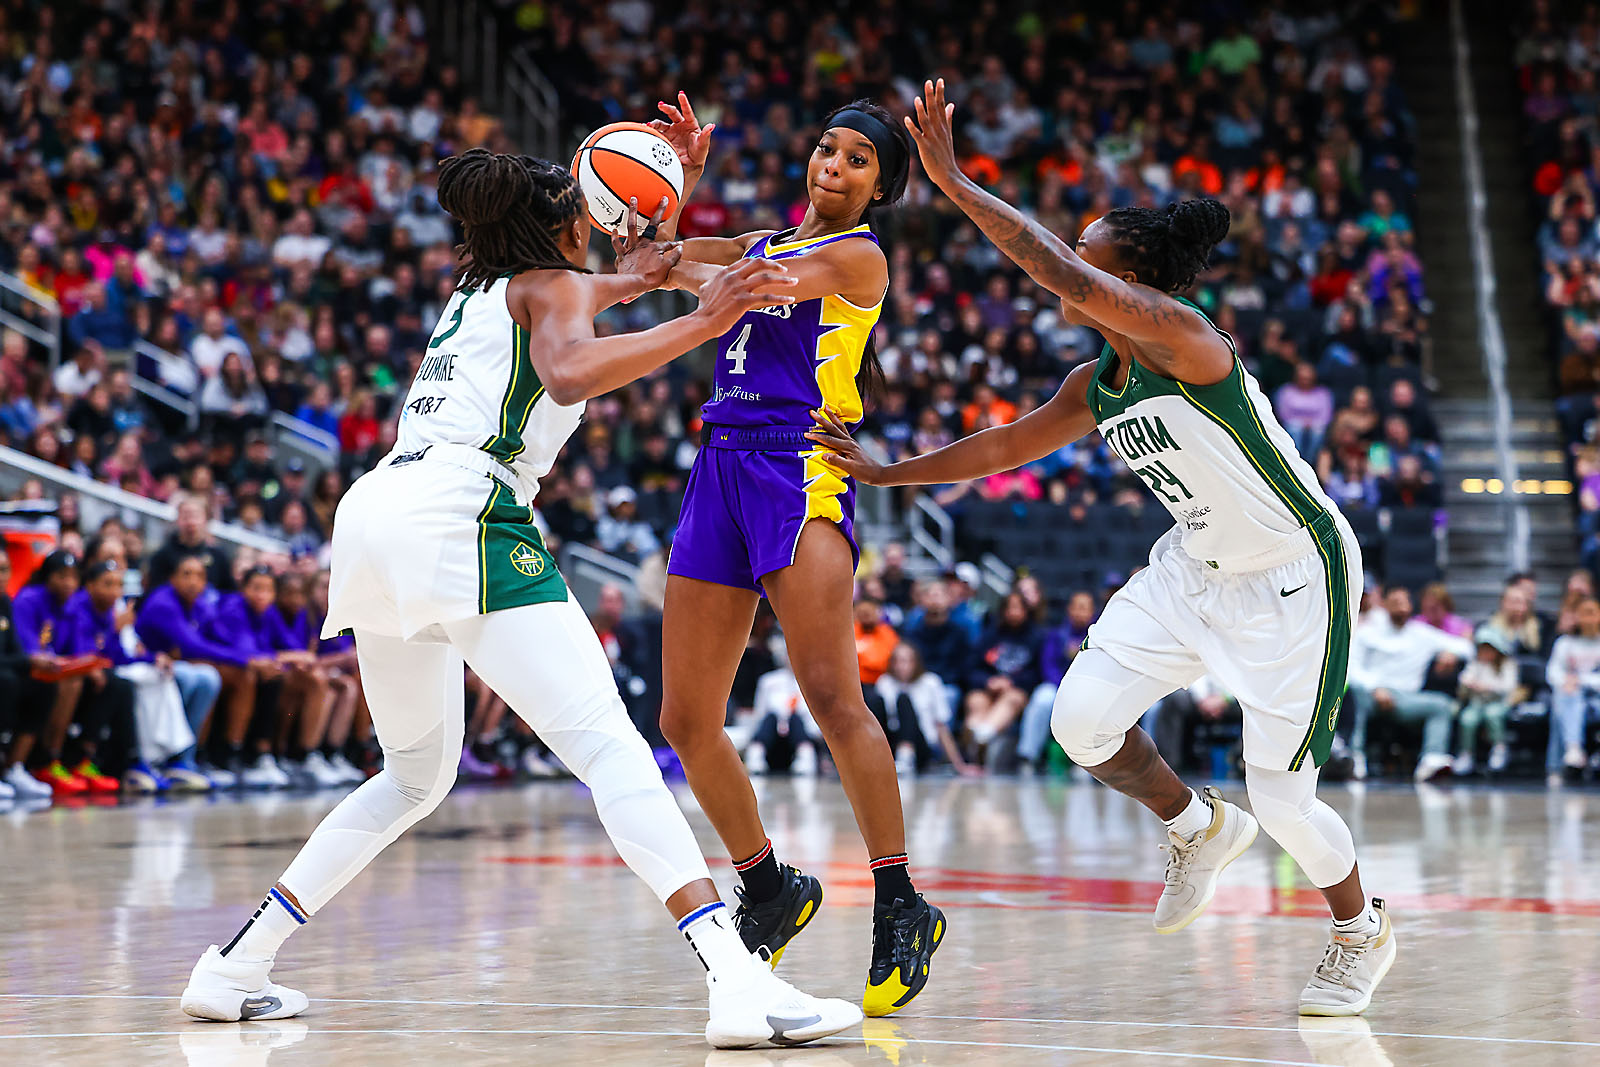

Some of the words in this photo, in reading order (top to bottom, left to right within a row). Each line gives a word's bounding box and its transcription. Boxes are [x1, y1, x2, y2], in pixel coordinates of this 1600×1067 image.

[725, 323, 753, 375] 4
[407, 396, 447, 416] AT&T
[1103, 415, 1183, 467] TORM
[1134, 459, 1195, 504] 24
